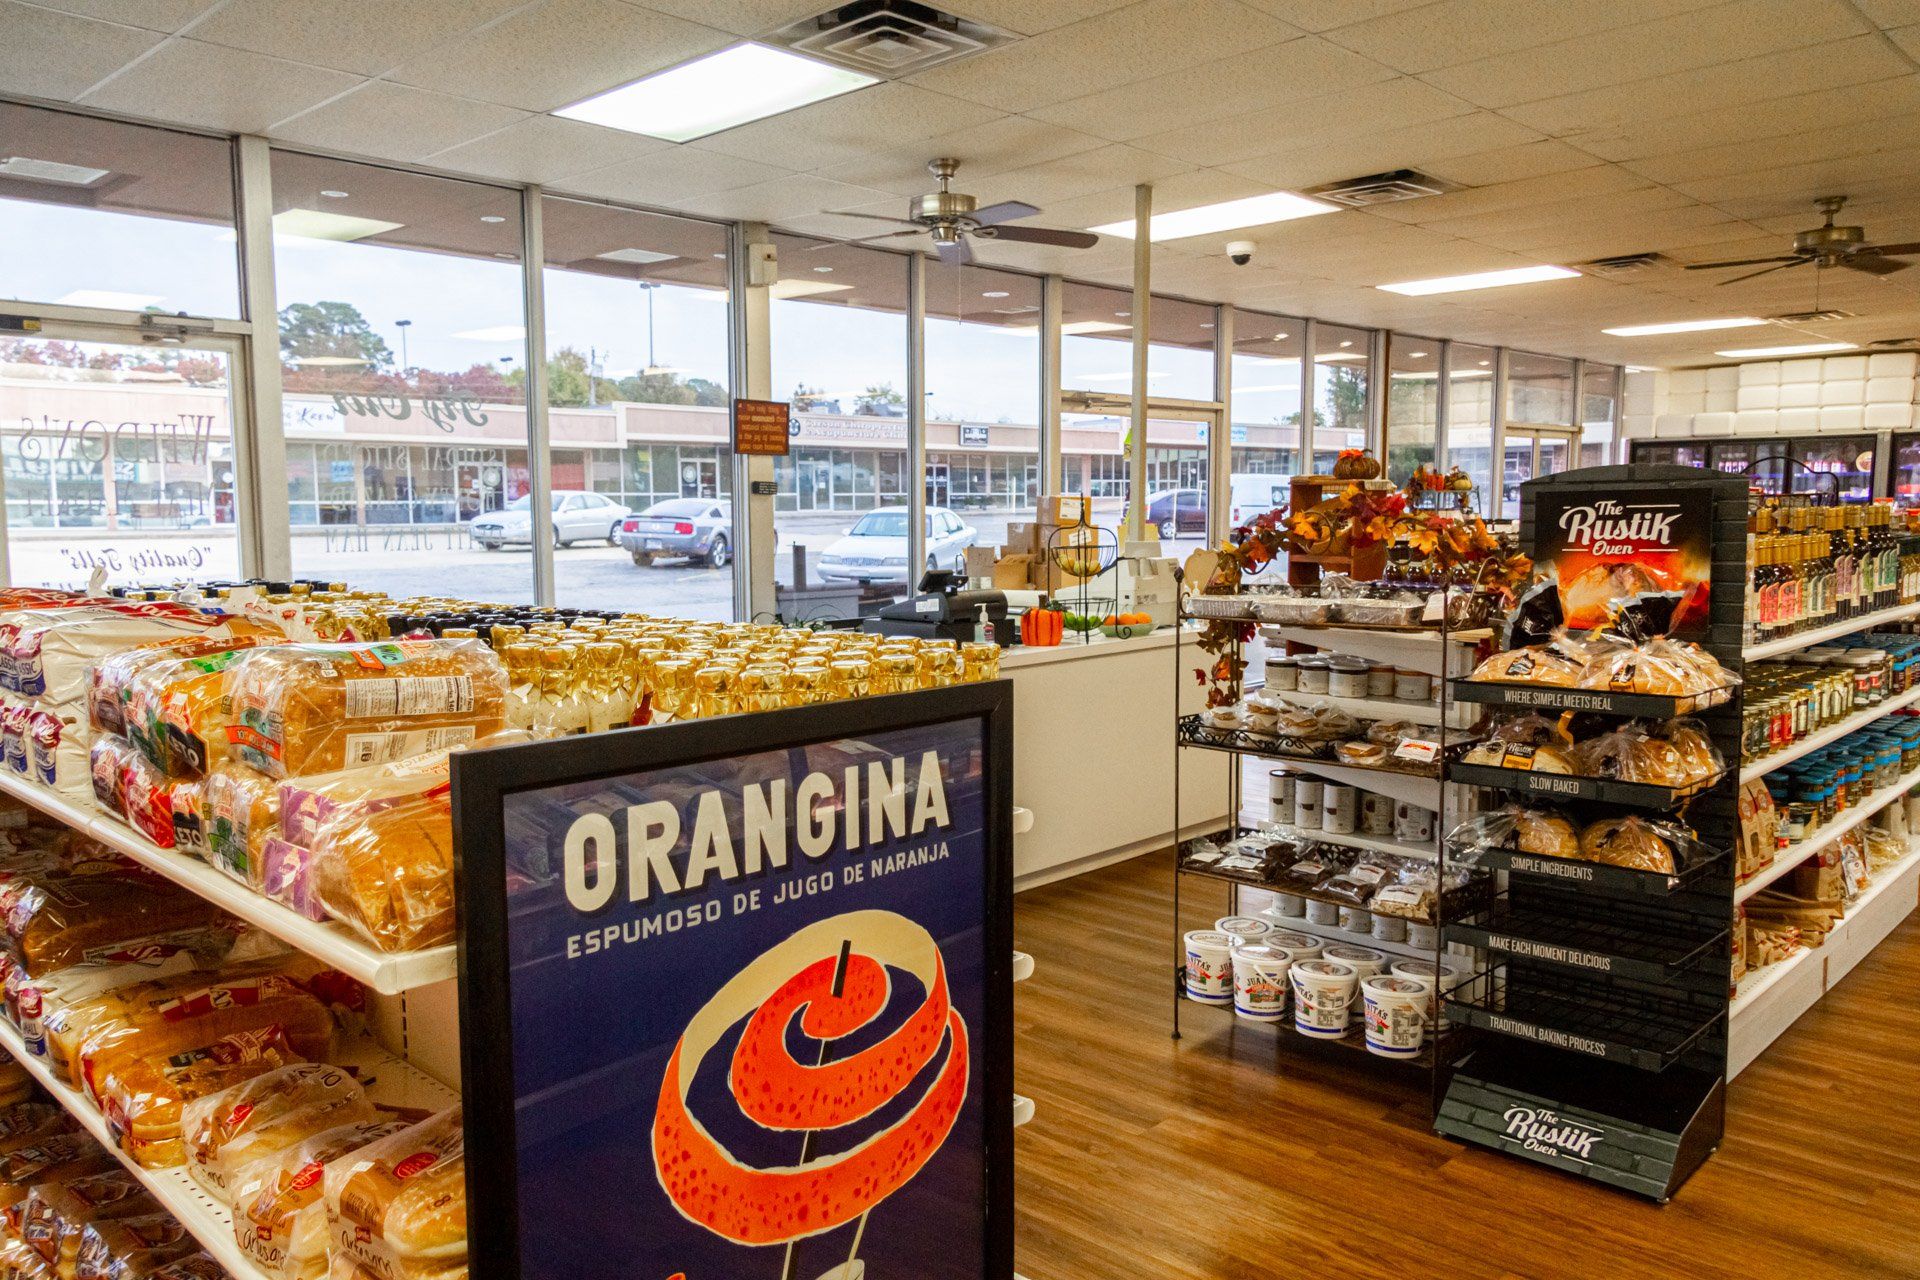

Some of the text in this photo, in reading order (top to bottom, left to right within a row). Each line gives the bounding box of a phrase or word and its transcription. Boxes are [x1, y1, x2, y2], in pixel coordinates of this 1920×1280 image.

[882, 431, 908, 441] Clini
[1594, 500, 1624, 517] The
[1558, 506, 1683, 546] Rustik
[1592, 540, 1635, 556] Oven
[1504, 690, 1613, 711] WHERE SIMPLE MEETS REAL
[1529, 777, 1580, 795] SLOW BAKED
[563, 750, 951, 913] ORANGINA
[1511, 857, 1594, 882] SIMPLE INGREDIENTS
[567, 841, 950, 960] ESPUMOSO DE JUGO DE NARANJA
[1489, 935, 1611, 971] MAKE EACH MOMENT DELICIOUS
[1489, 1016, 1606, 1056] TRADITIONAL BAKING PROCESS
[1536, 1108, 1560, 1125] The
[1503, 1106, 1604, 1158] Rustik
[1523, 1137, 1558, 1157] Oven
